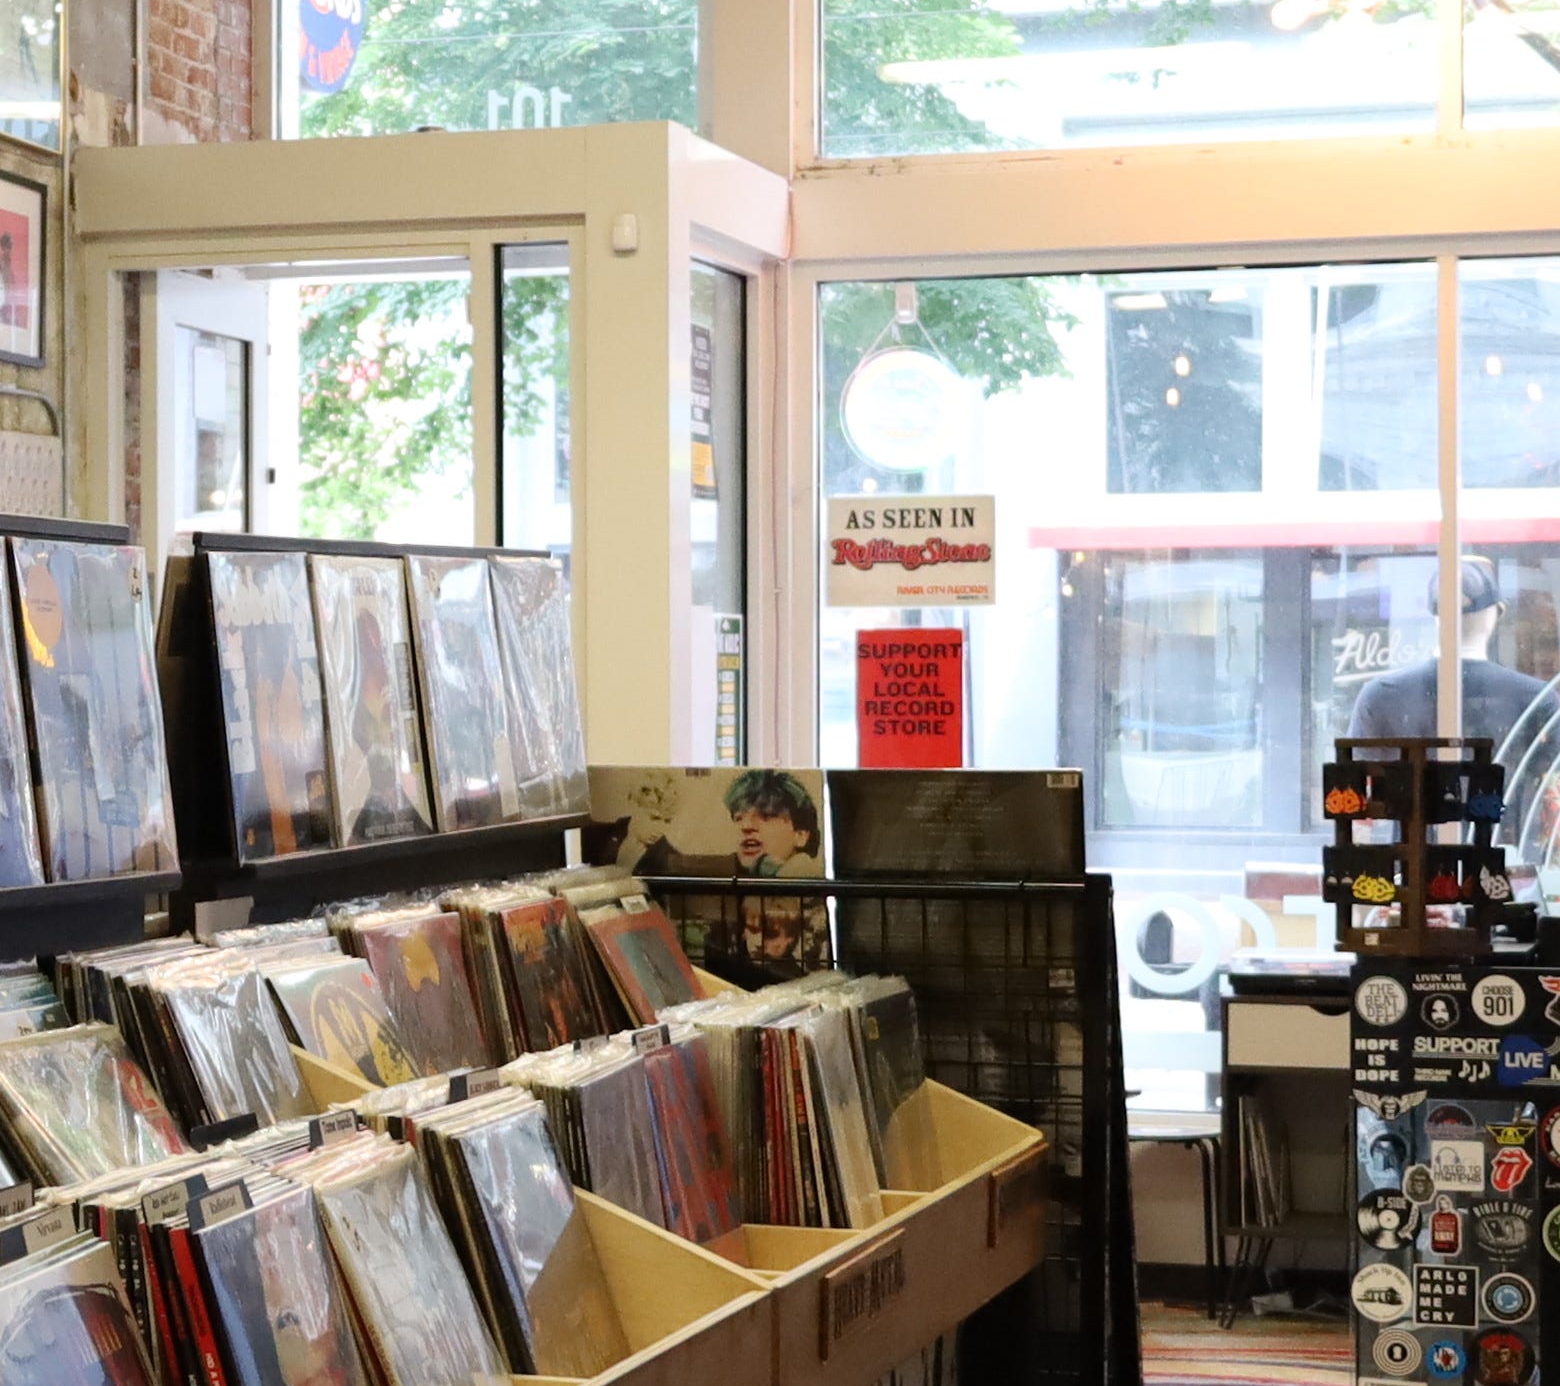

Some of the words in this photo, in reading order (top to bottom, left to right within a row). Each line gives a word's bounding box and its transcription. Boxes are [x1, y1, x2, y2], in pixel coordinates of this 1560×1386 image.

[845, 509, 876, 530] AS
[882, 507, 943, 529] SEEN
[951, 506, 976, 528] IN
[857, 642, 962, 660] SUPPORT
[880, 663, 940, 678] YOUR
[873, 681, 945, 698] LOCAL
[864, 699, 956, 717] RECORD
[872, 719, 946, 736] STORE
[1443, 974, 1464, 984] THE
[1412, 982, 1468, 993] NIGHTMARE
[1483, 996, 1514, 1017] 901
[1354, 1038, 1400, 1051] HOPE
[1413, 1036, 1500, 1055] SUPPORT
[1368, 1054, 1385, 1067] IS
[1504, 1051, 1544, 1069] LIVE
[1354, 1069, 1400, 1082] DOPE
[1419, 1283, 1468, 1296] MADE
[1420, 1296, 1443, 1308] ME
[1420, 1310, 1455, 1323] CRY
